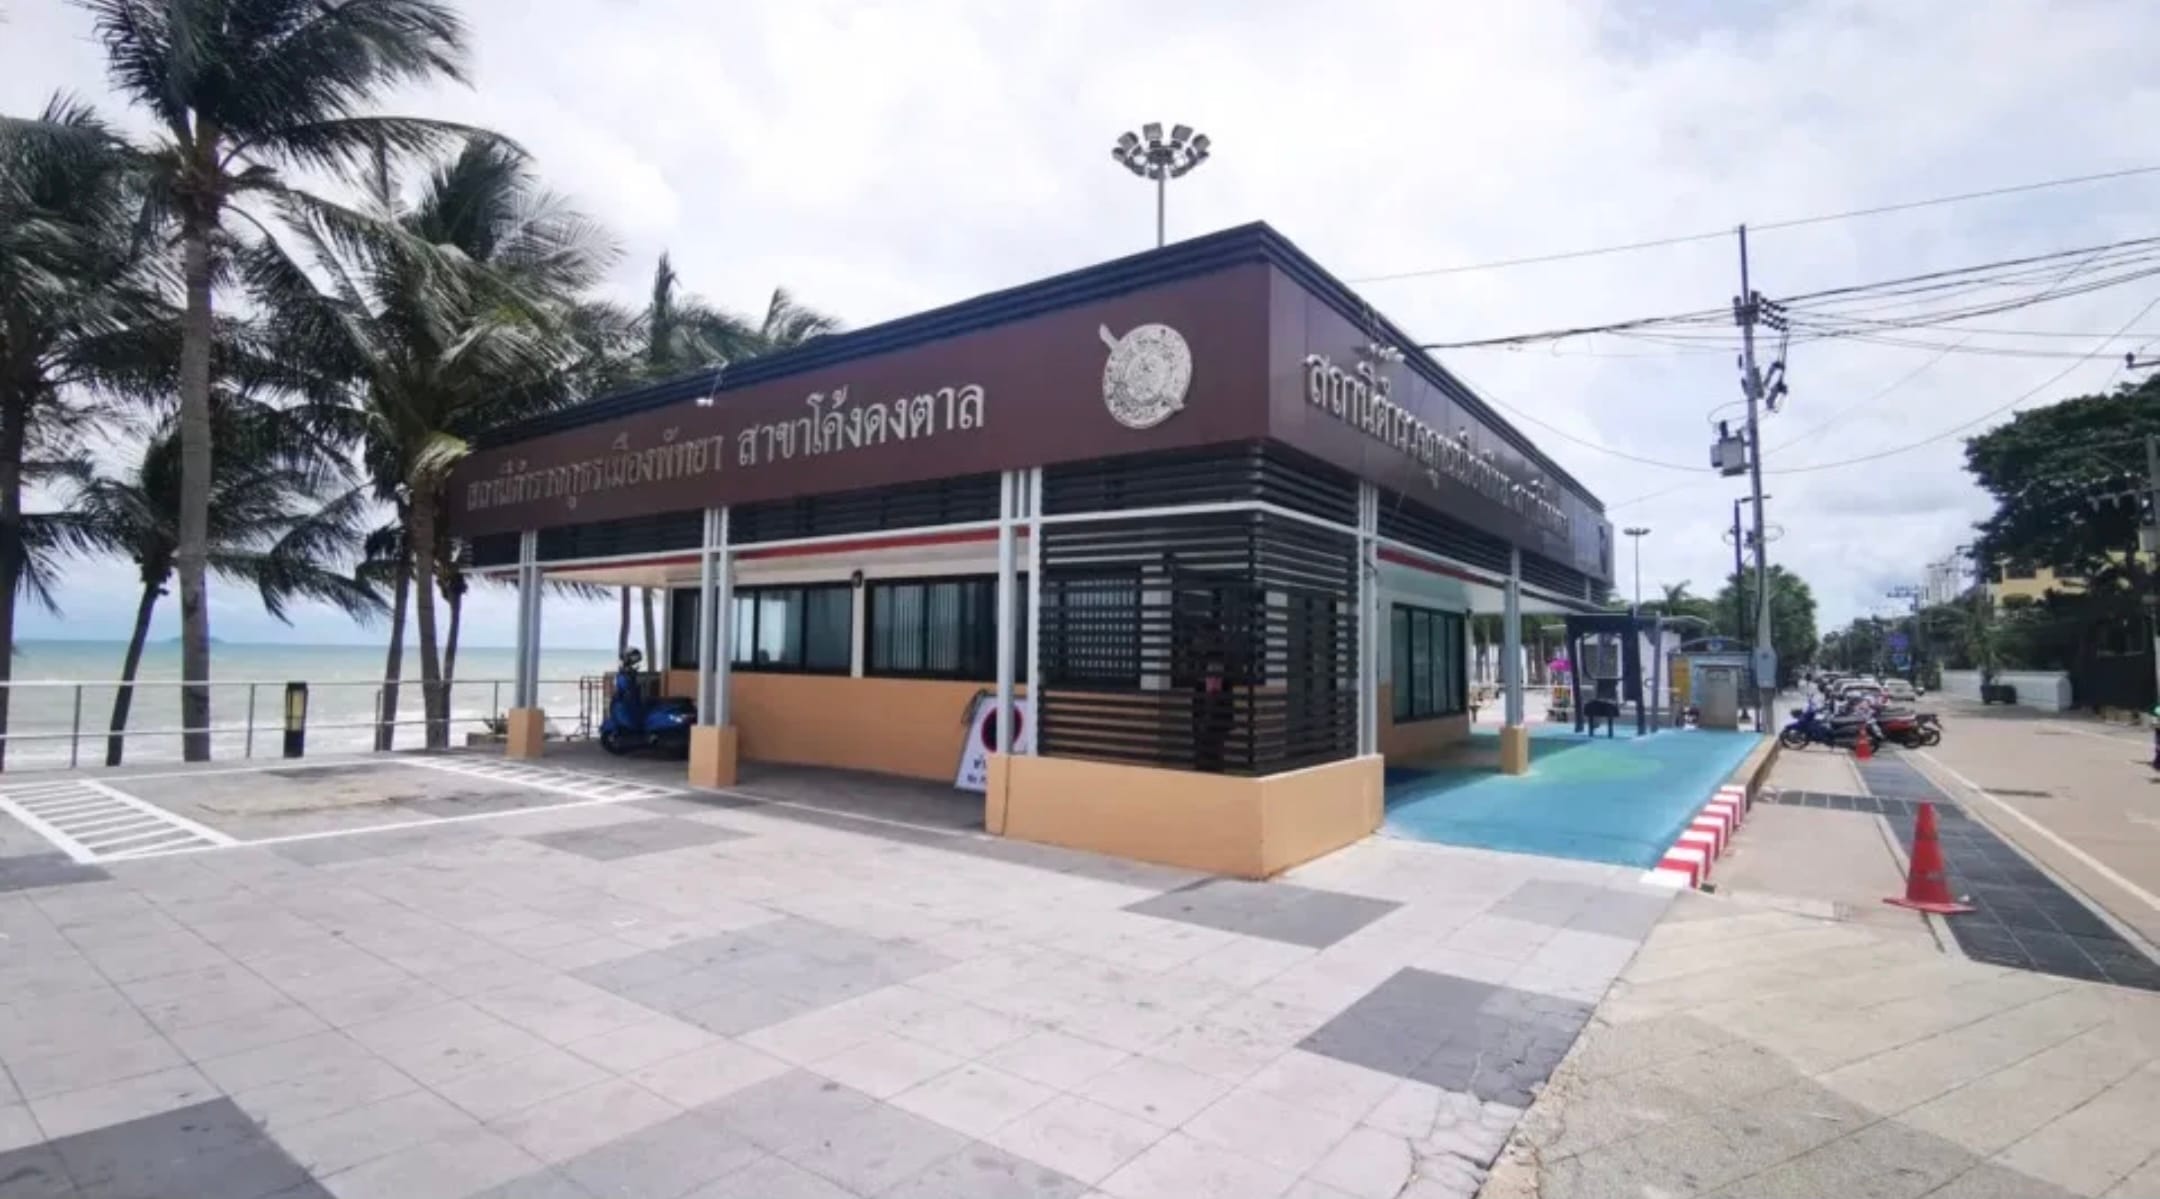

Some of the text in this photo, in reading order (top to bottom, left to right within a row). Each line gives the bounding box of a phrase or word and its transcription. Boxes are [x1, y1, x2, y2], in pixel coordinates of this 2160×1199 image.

[737, 384, 985, 466] สาขาโค้งดงตาล
